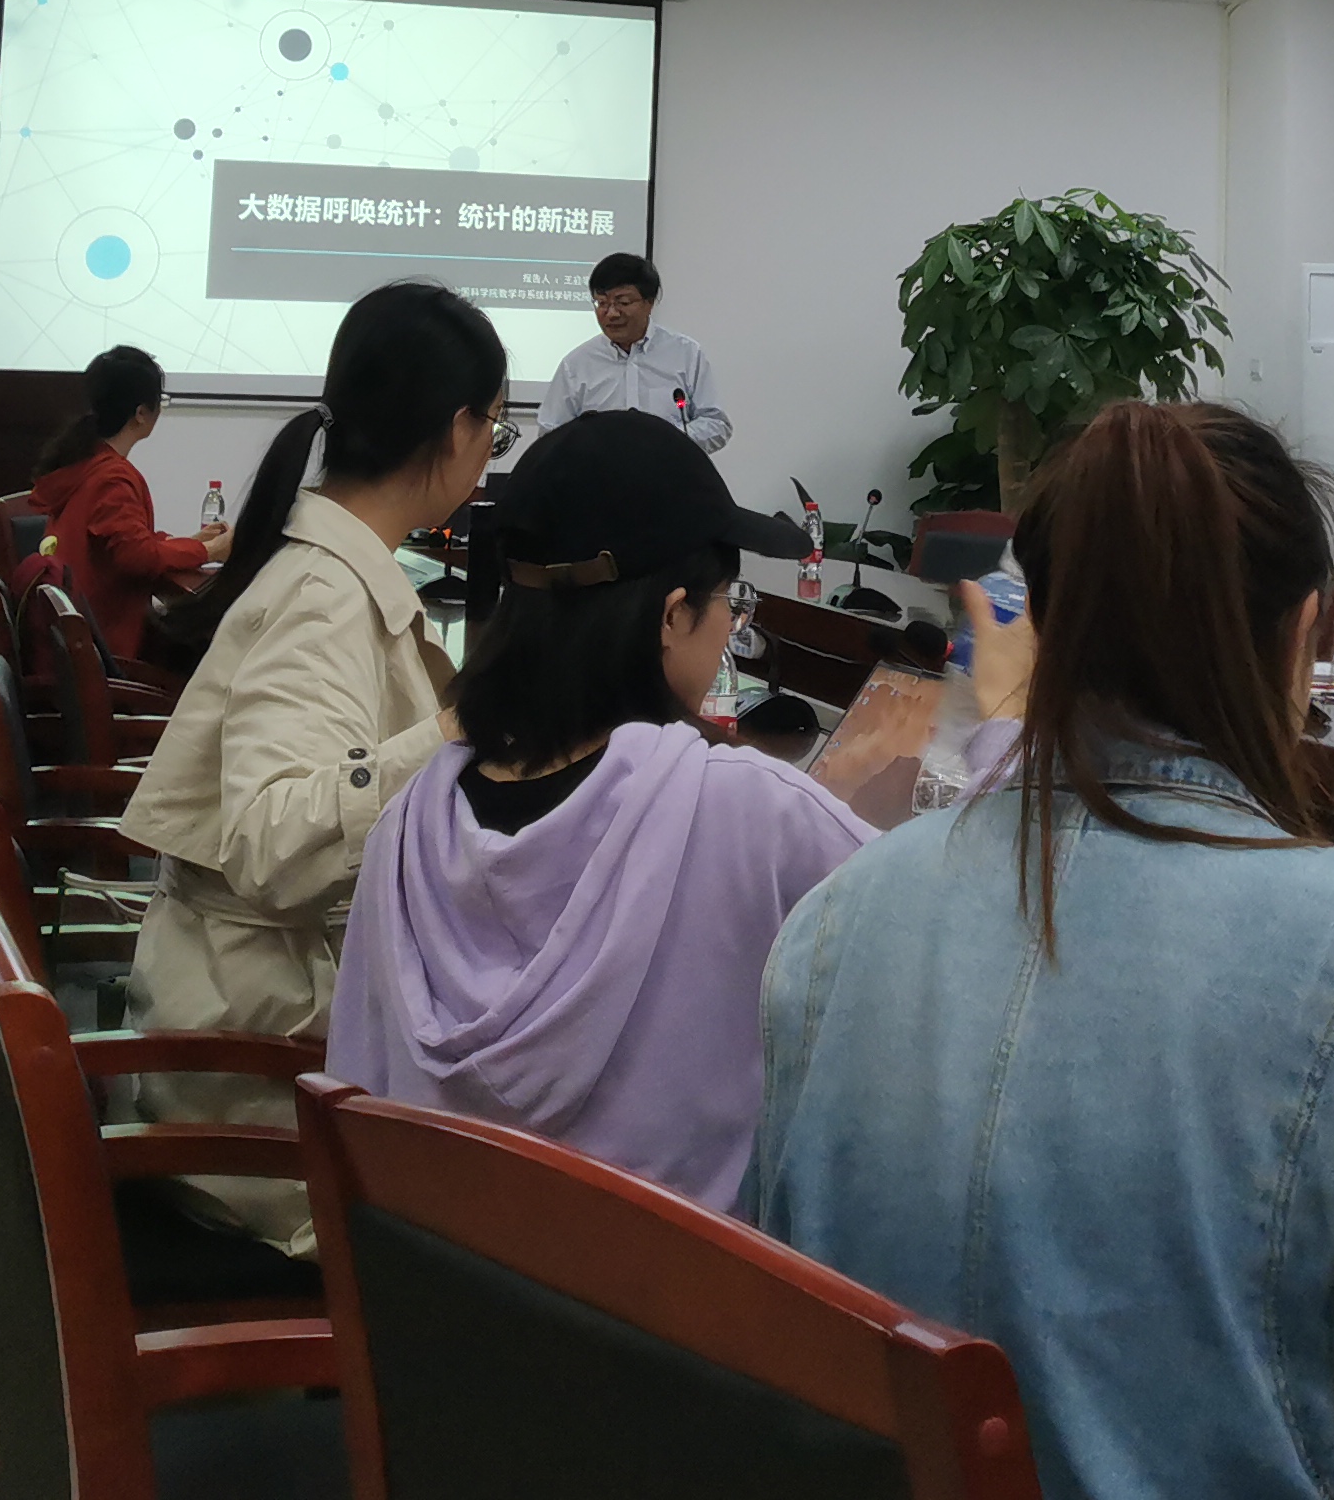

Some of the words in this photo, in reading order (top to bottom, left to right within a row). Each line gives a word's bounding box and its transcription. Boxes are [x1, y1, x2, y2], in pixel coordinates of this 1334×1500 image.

[238, 193, 615, 237] 大数据呼唤统计：统计的新进展
